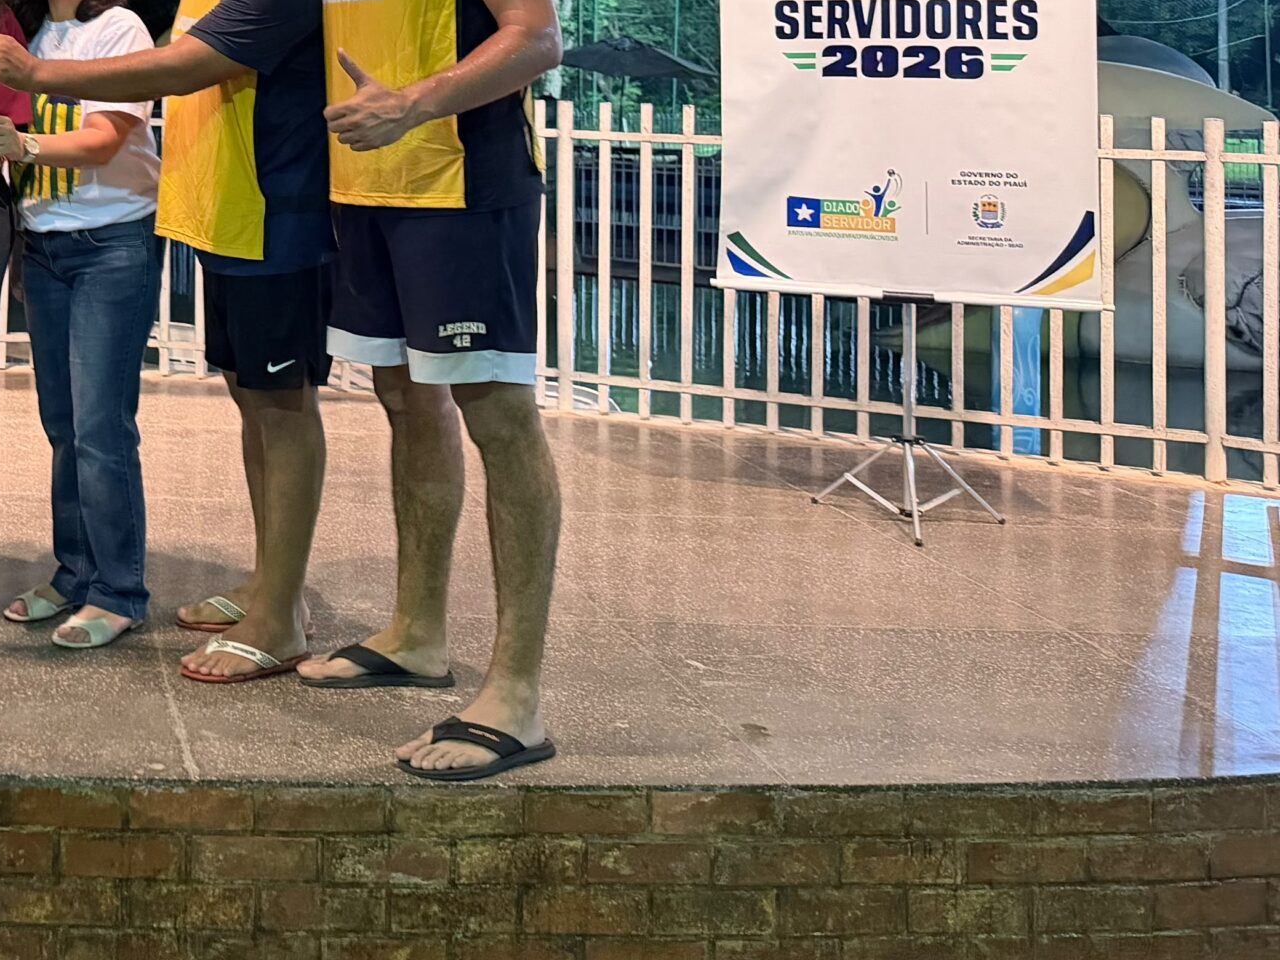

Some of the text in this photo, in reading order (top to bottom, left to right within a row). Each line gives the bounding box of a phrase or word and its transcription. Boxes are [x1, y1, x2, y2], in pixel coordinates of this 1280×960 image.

[822, 45, 984, 80] 2026
[1003, 180, 1027, 188] PIAUÍ
[823, 217, 891, 230] SERVIDOR
[438, 321, 487, 337] LEGEND
[453, 334, 471, 347] 42
